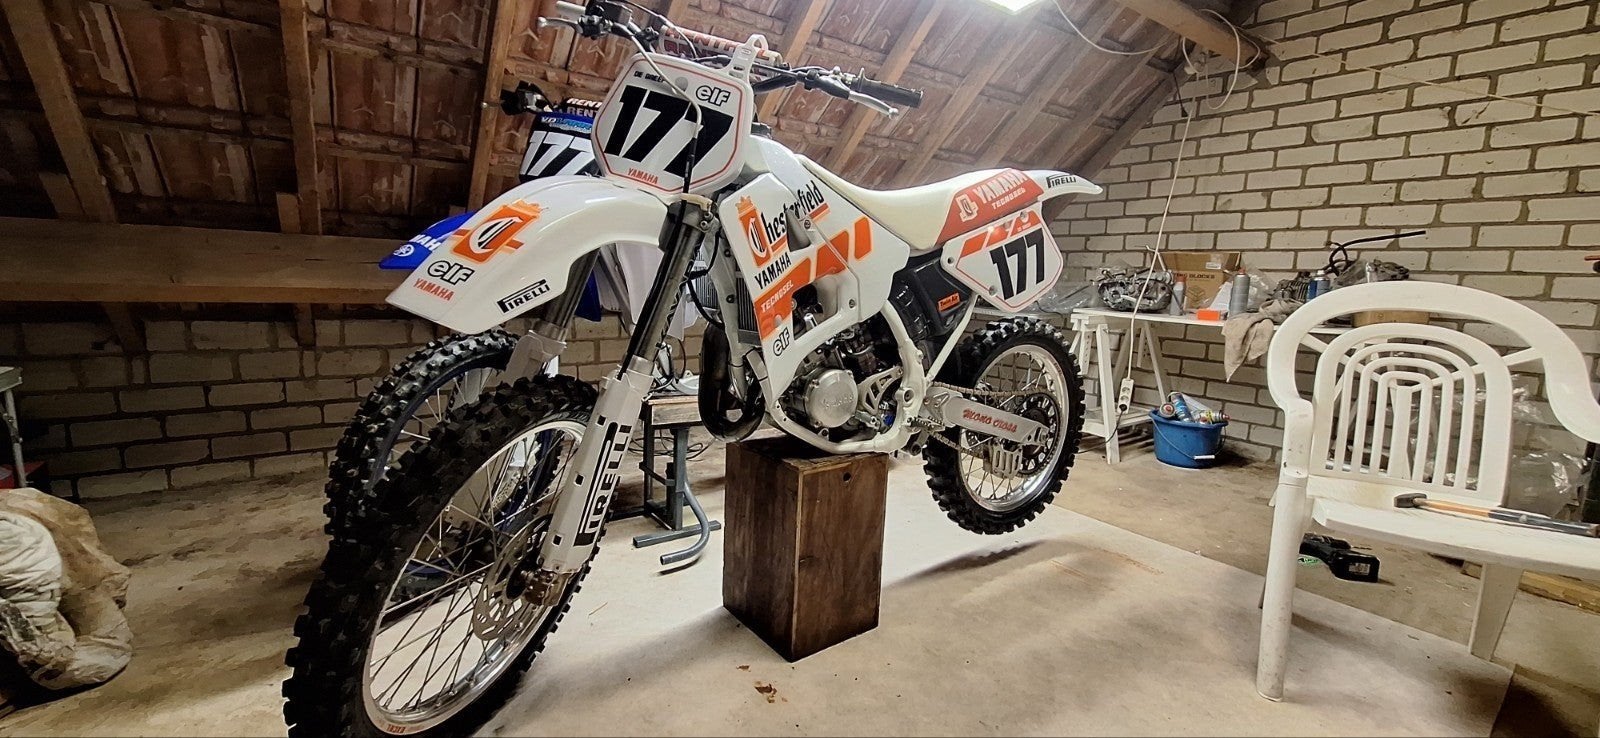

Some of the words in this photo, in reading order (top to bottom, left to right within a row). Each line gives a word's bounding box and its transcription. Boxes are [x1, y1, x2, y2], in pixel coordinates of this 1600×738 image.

[664, 26, 770, 61] RENTHL
[695, 85, 731, 107] elf
[603, 85, 734, 179] 177
[520, 131, 597, 177] 177
[627, 168, 659, 185] YAMAHA
[973, 168, 1029, 204] YAMAHA
[1046, 174, 1077, 188] PIRELLI
[427, 260, 475, 286] elf
[754, 252, 792, 290] YAMAHA
[989, 228, 1045, 300] 177
[413, 278, 455, 301] YAMAHA
[497, 279, 551, 313] PIRELLI
[773, 326, 791, 356] elf
[573, 421, 633, 547] PIRELLI
